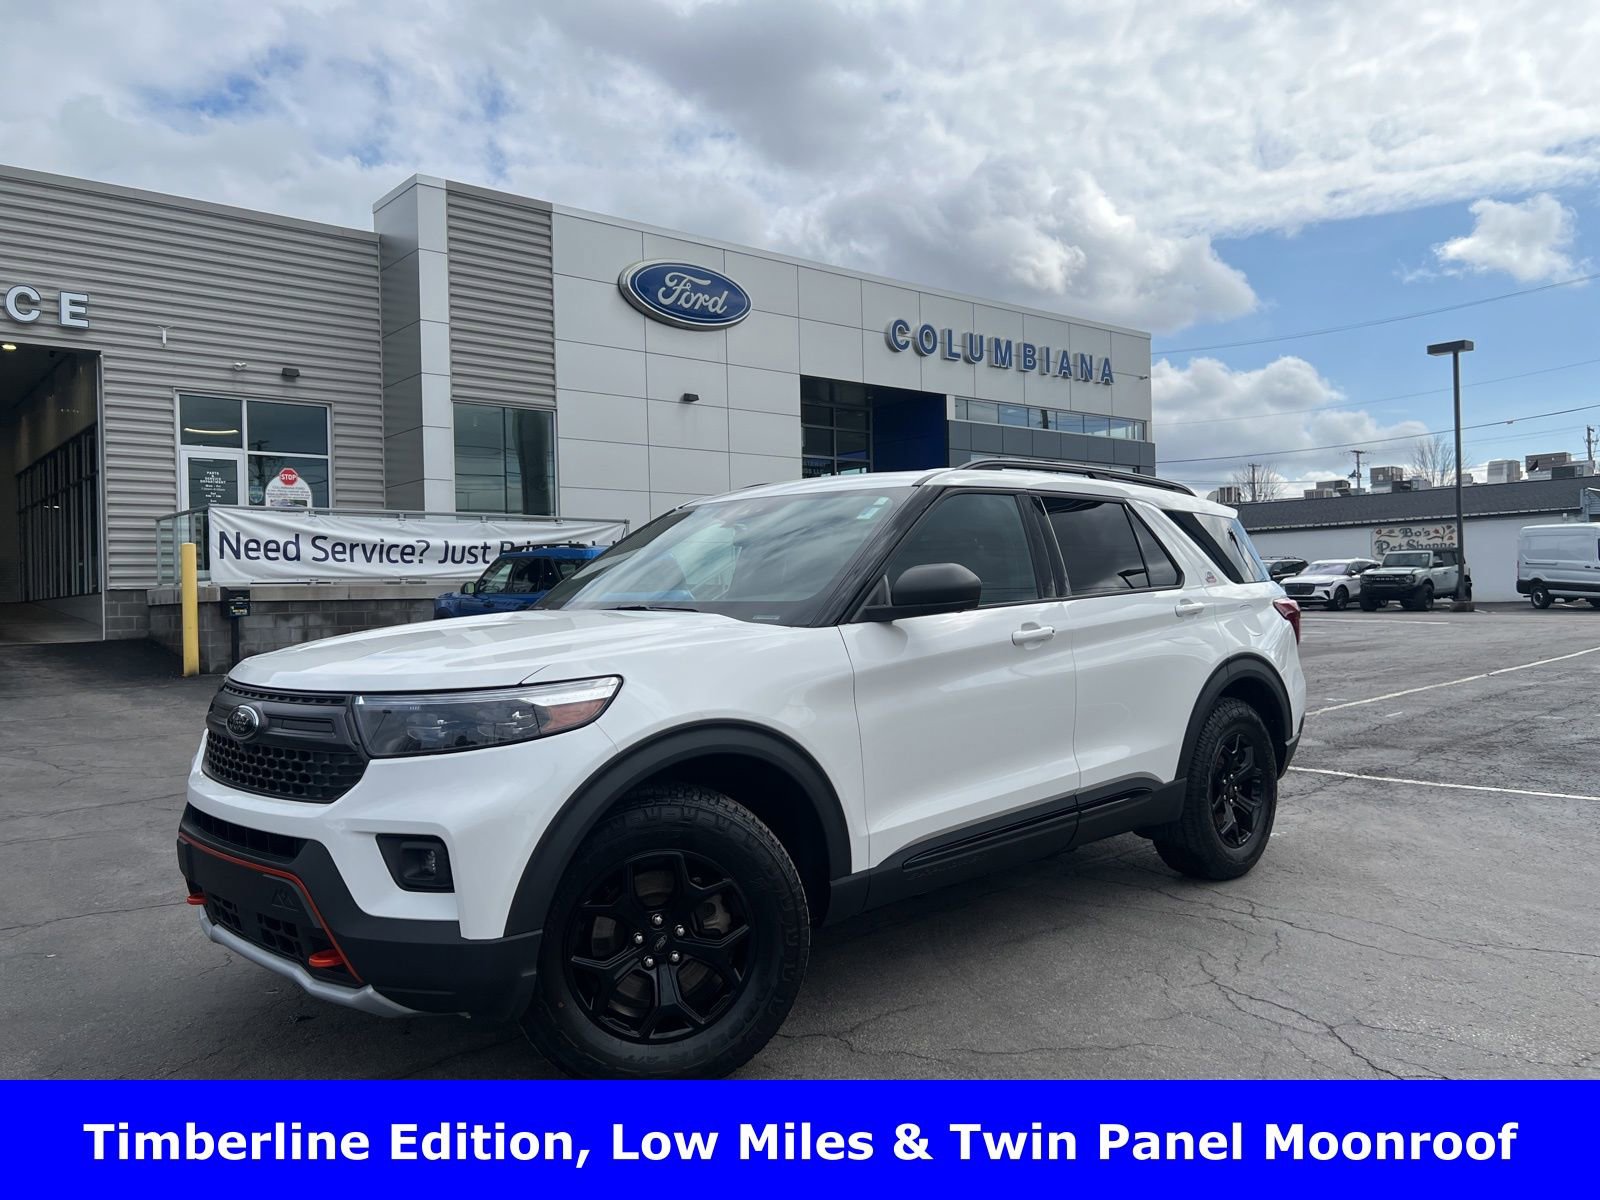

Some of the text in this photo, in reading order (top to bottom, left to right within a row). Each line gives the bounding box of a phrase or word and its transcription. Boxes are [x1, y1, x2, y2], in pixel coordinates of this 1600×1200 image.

[5, 284, 90, 328] CE
[657, 271, 729, 314] Ford
[885, 318, 1115, 386] COLUMBIANA
[281, 473, 297, 481] STOP
[218, 531, 301, 561] Need
[311, 534, 431, 564] Service?
[438, 540, 491, 564] Just
[1375, 539, 1404, 555] Pet
[1399, 527, 1431, 538] Bo's
